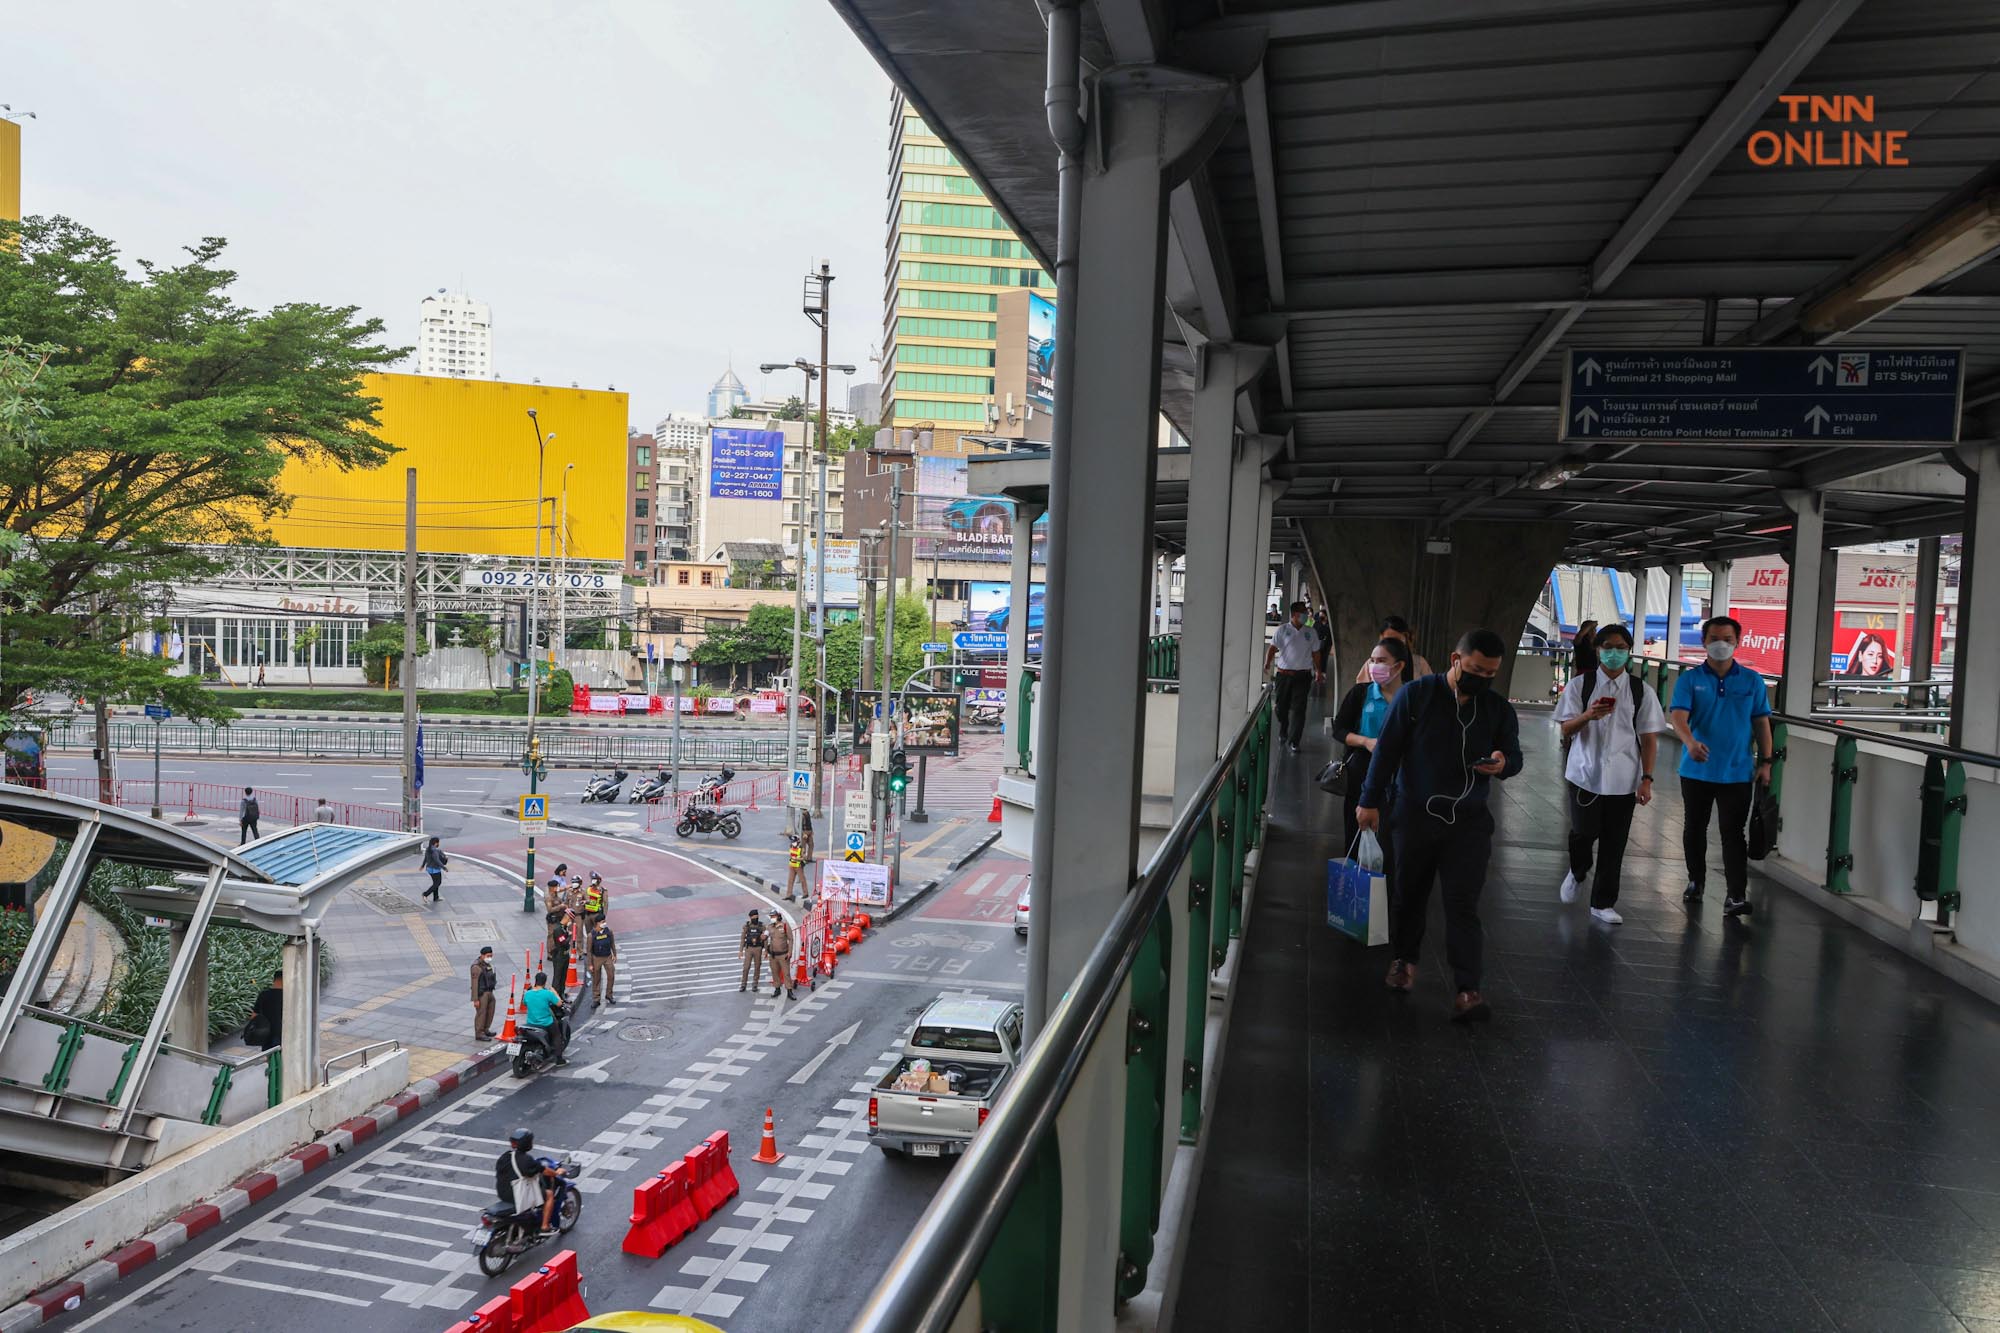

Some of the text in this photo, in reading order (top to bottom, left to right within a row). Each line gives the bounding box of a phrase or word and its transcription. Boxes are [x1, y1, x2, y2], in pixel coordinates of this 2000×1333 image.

[1721, 360, 1732, 369] 21
[1605, 373, 1737, 384] Terminal 21 Shopping Mall
[1874, 372, 1948, 383] BTS SkyTrain
[1659, 415, 1670, 424] 21
[1834, 413, 1877, 421] ทางออก
[1601, 429, 1793, 437] Grande Centre Point Hotel Terminal 21
[1833, 426, 1854, 435] Exit
[720, 449, 774, 457] 02-653-2999
[720, 472, 773, 480] 02-227-0447
[719, 489, 773, 497] 02-261-1600
[956, 532, 1014, 544] BLADE BATT
[482, 572, 604, 587] 092 2767078
[1747, 569, 1785, 586] J&T
[1867, 614, 1885, 629] VS
